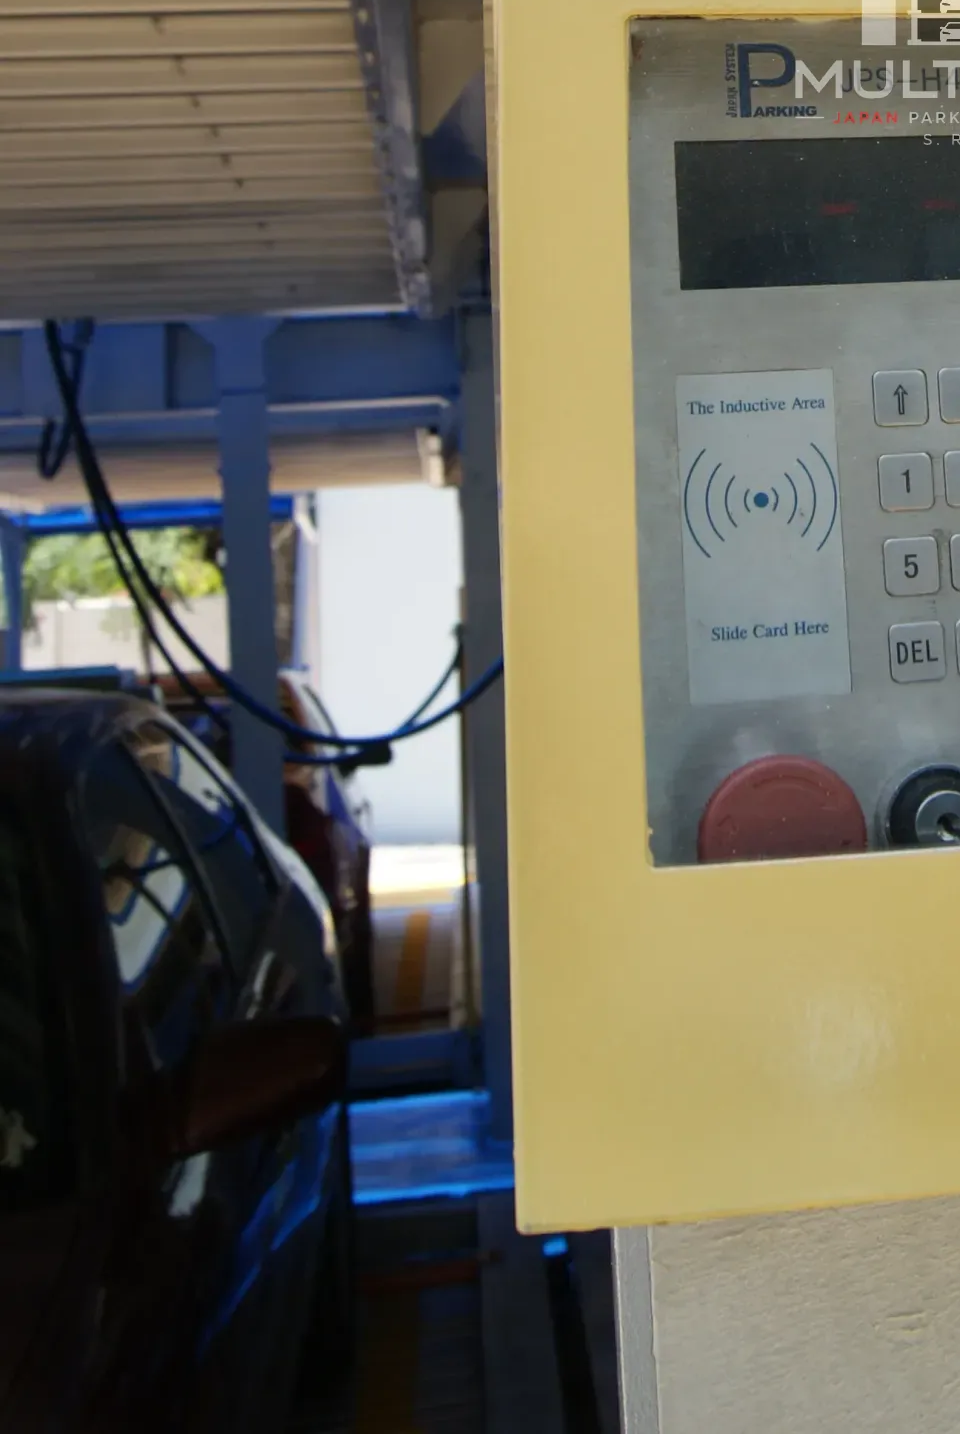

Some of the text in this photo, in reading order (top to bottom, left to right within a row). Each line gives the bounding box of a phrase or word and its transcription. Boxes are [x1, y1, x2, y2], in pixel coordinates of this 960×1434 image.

[686, 396, 826, 415] The Inductive Area
[901, 469, 912, 493] 1
[904, 554, 919, 579] 5
[711, 621, 830, 642] Slide Card Here
[896, 639, 939, 665] DEL
